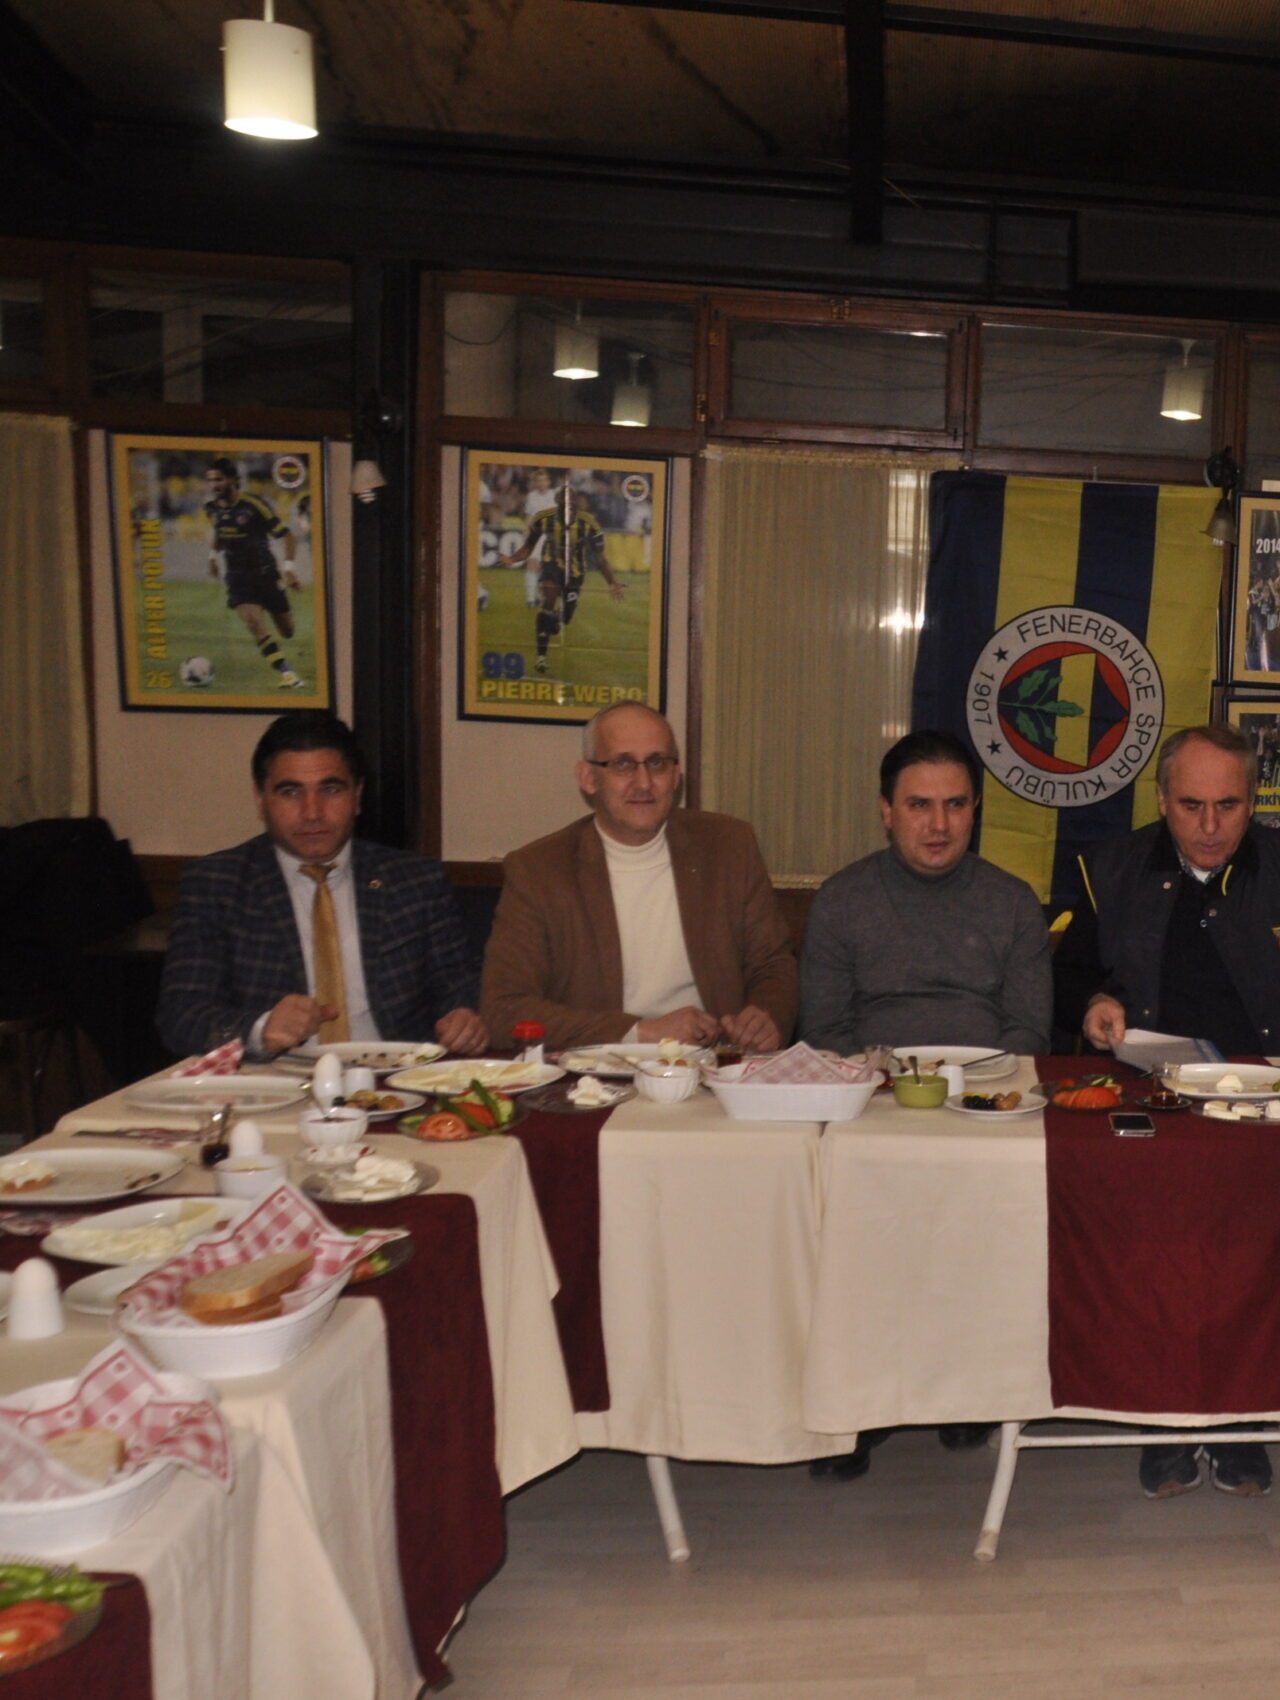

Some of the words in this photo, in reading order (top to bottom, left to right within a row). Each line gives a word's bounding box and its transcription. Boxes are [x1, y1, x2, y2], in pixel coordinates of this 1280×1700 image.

[140, 518, 165, 591] POTUK
[143, 595, 168, 659] ALPER
[146, 671, 172, 689] 26
[482, 651, 526, 679] 99
[1016, 614, 1157, 702] FENERBAHÇE
[481, 679, 568, 700] PIERRE
[972, 670, 995, 727] 1907
[1109, 712, 1156, 780] SPOR
[1004, 765, 1108, 804] KULÜBÜ
